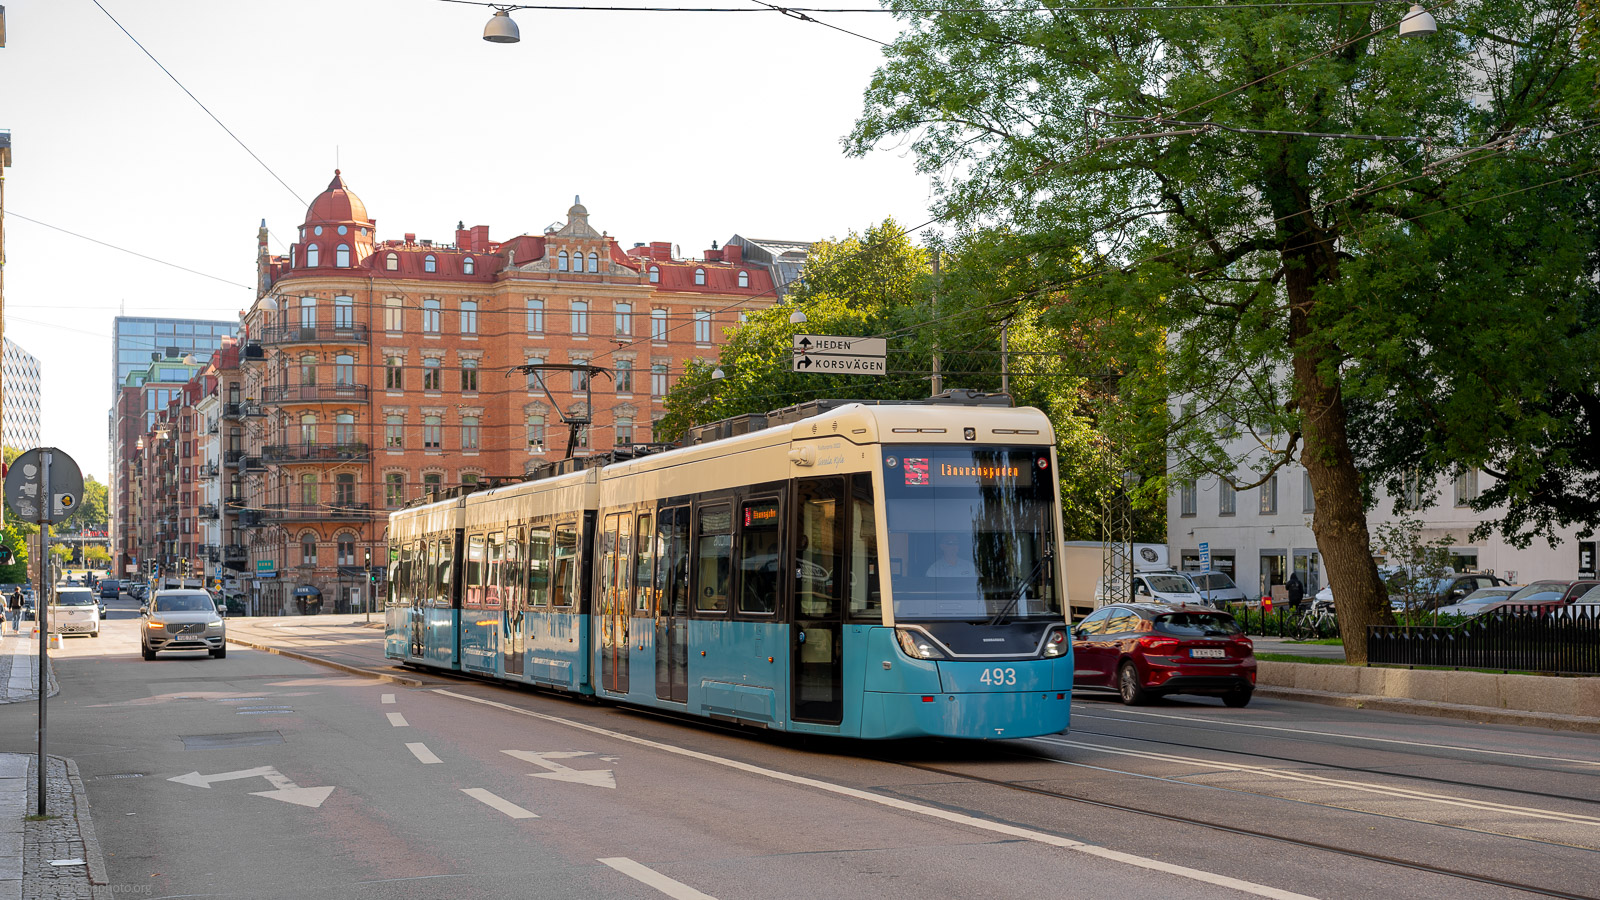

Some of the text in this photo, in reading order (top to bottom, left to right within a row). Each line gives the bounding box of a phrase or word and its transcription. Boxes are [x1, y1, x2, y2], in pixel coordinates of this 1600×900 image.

[816, 340, 851, 350] HEDEN
[815, 359, 883, 370] KORSVÄGEN
[1582, 551, 1591, 569] E
[980, 667, 1017, 686] 493
